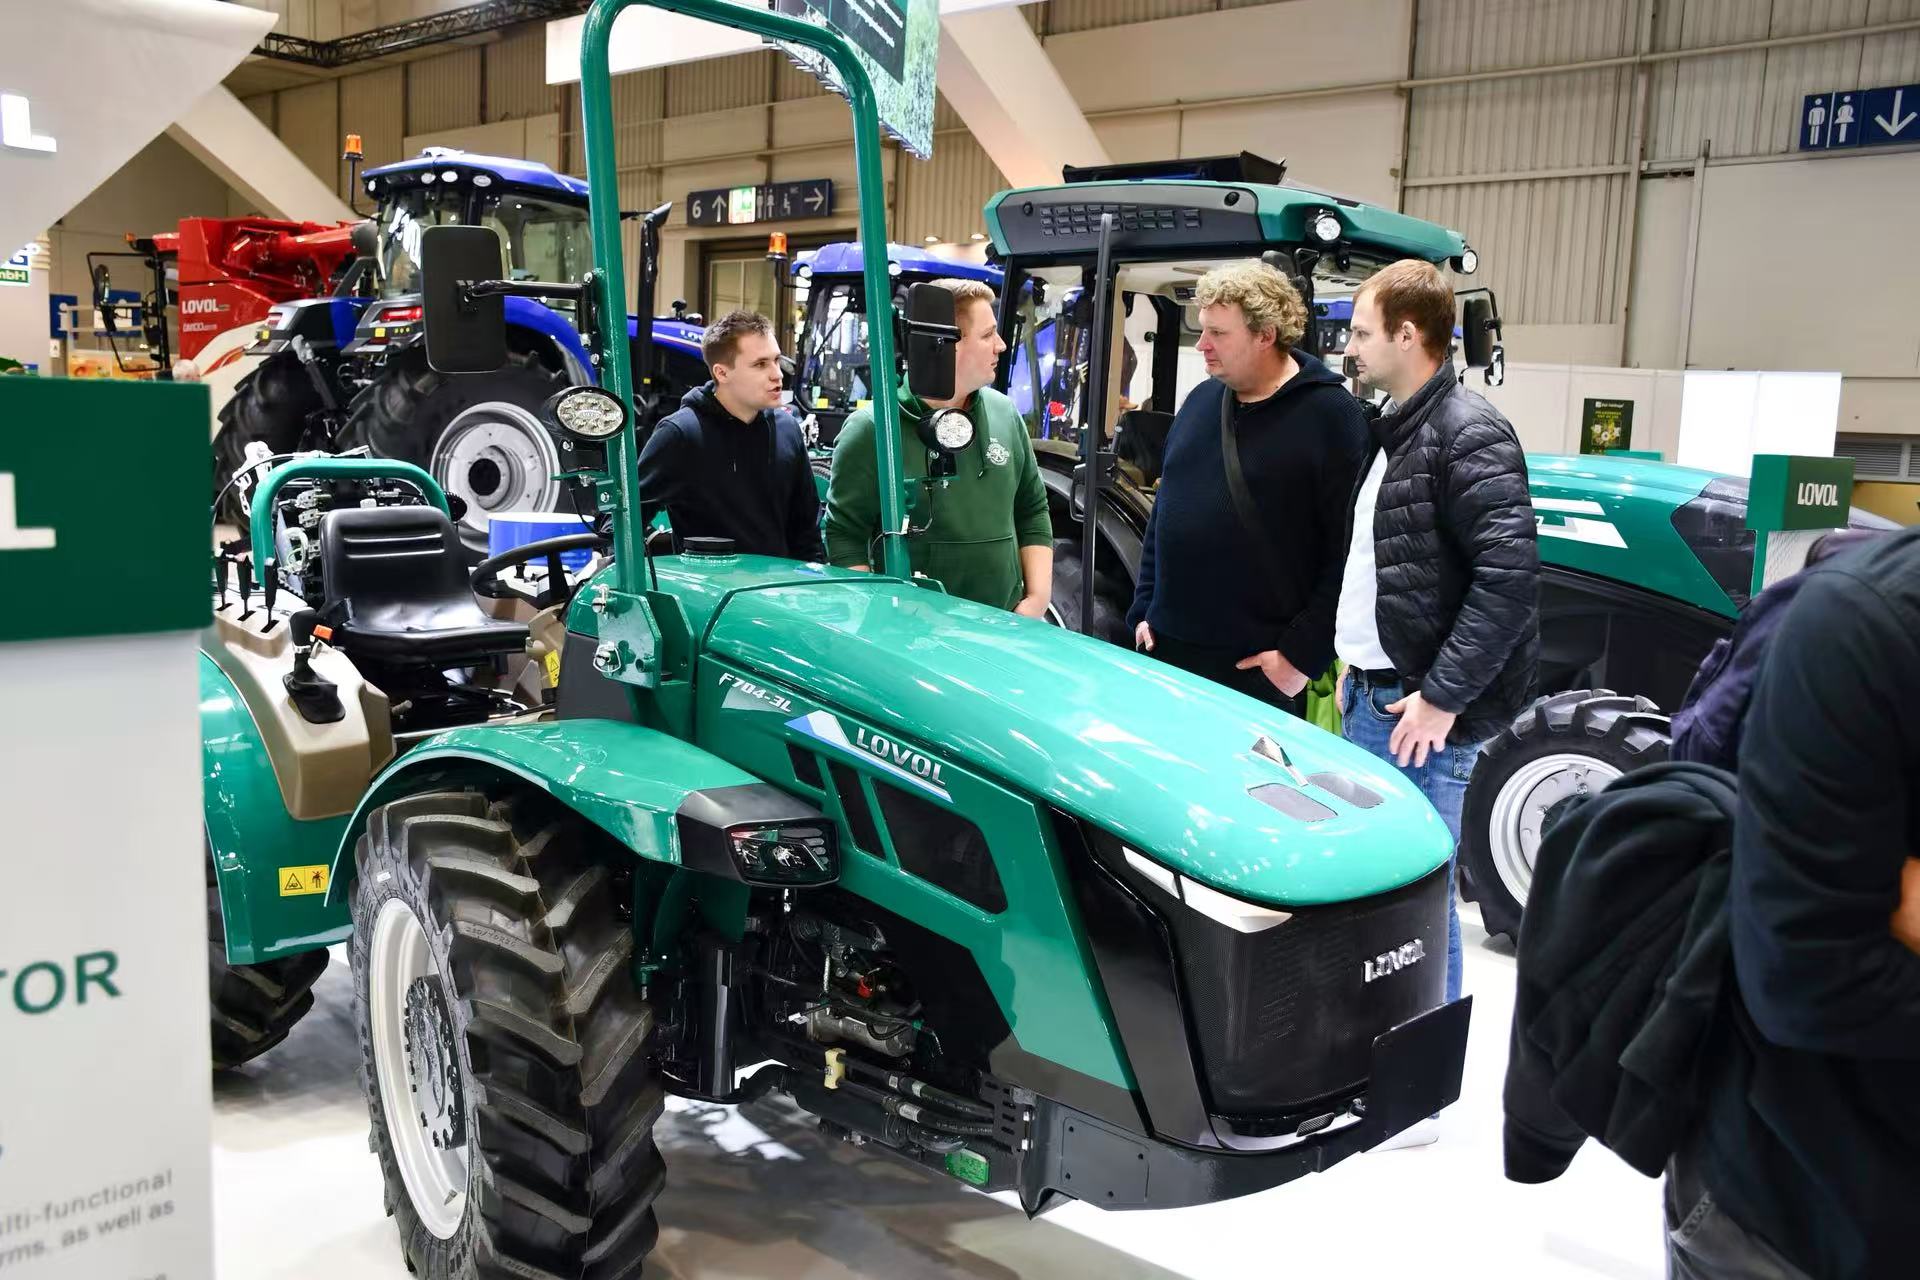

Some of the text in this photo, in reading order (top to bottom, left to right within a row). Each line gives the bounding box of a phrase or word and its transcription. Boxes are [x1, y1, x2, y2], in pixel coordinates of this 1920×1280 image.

[692, 200, 702, 219] 6
[182, 298, 219, 315] LOVOL
[1797, 482, 1839, 507] LOVOL
[718, 672, 793, 713] F704-3L
[856, 727, 947, 785] LOVOL
[1363, 938, 1426, 983] LOVOL
[0, 950, 122, 1015] OR
[61, 1227, 90, 1248] as
[97, 1205, 142, 1234] well
[148, 1199, 175, 1221] as
